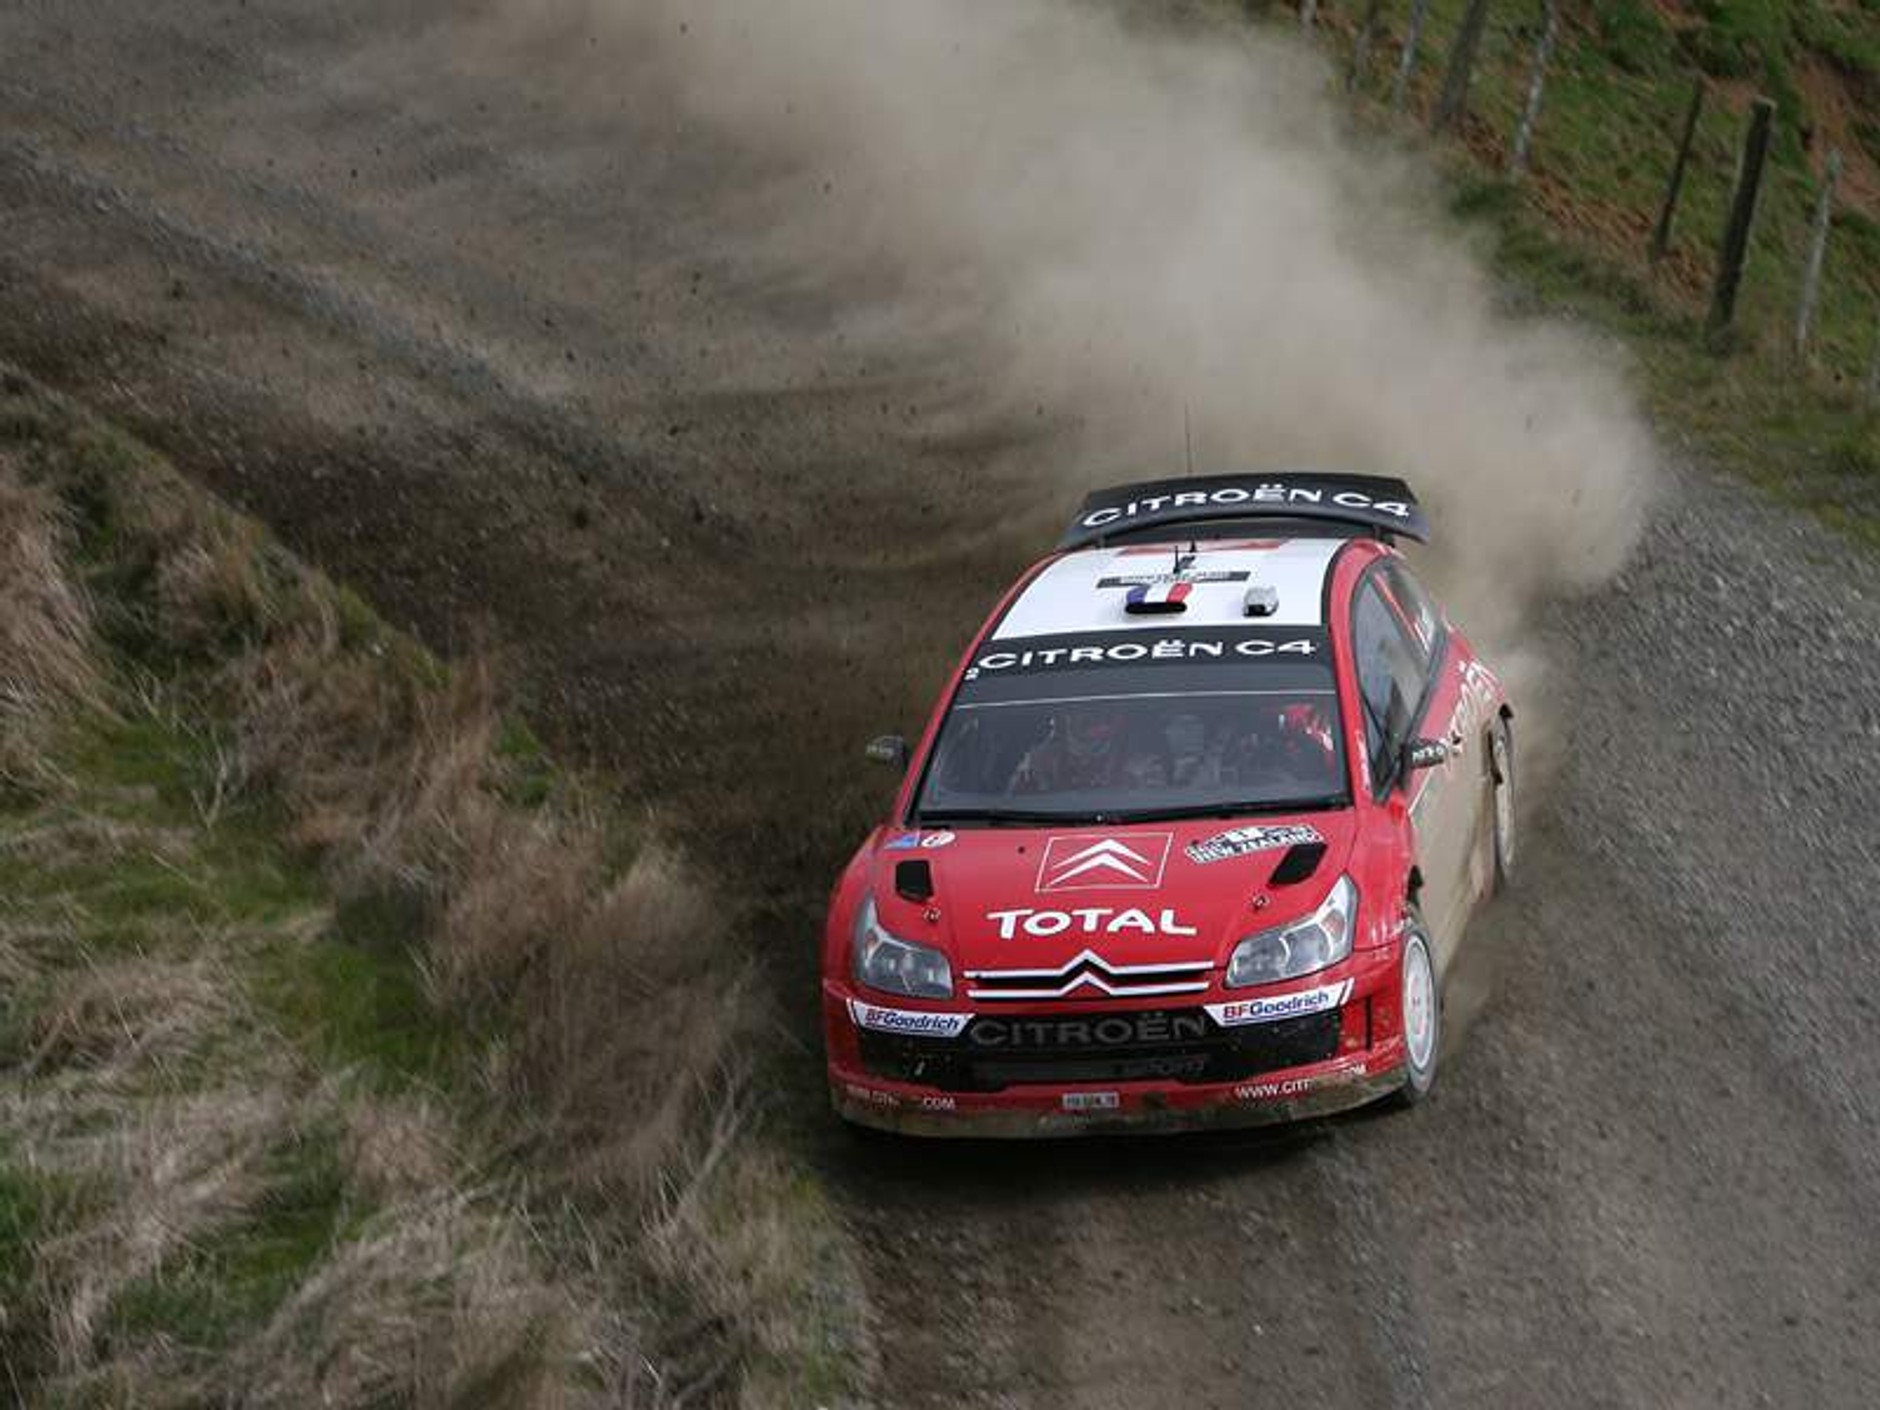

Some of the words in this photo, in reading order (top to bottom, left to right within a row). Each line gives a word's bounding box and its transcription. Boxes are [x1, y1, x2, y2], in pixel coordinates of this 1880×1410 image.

[1083, 484, 1330, 526] CITROËN
[1333, 492, 1410, 518] C4
[978, 640, 1223, 669] CITROËN
[1235, 640, 1316, 655] C4
[987, 908, 1198, 940] TOTAL
[866, 1008, 960, 1032] BFGoodrich
[1223, 991, 1329, 1019] BFGoodrich
[970, 1012, 1205, 1046] CITROËN
